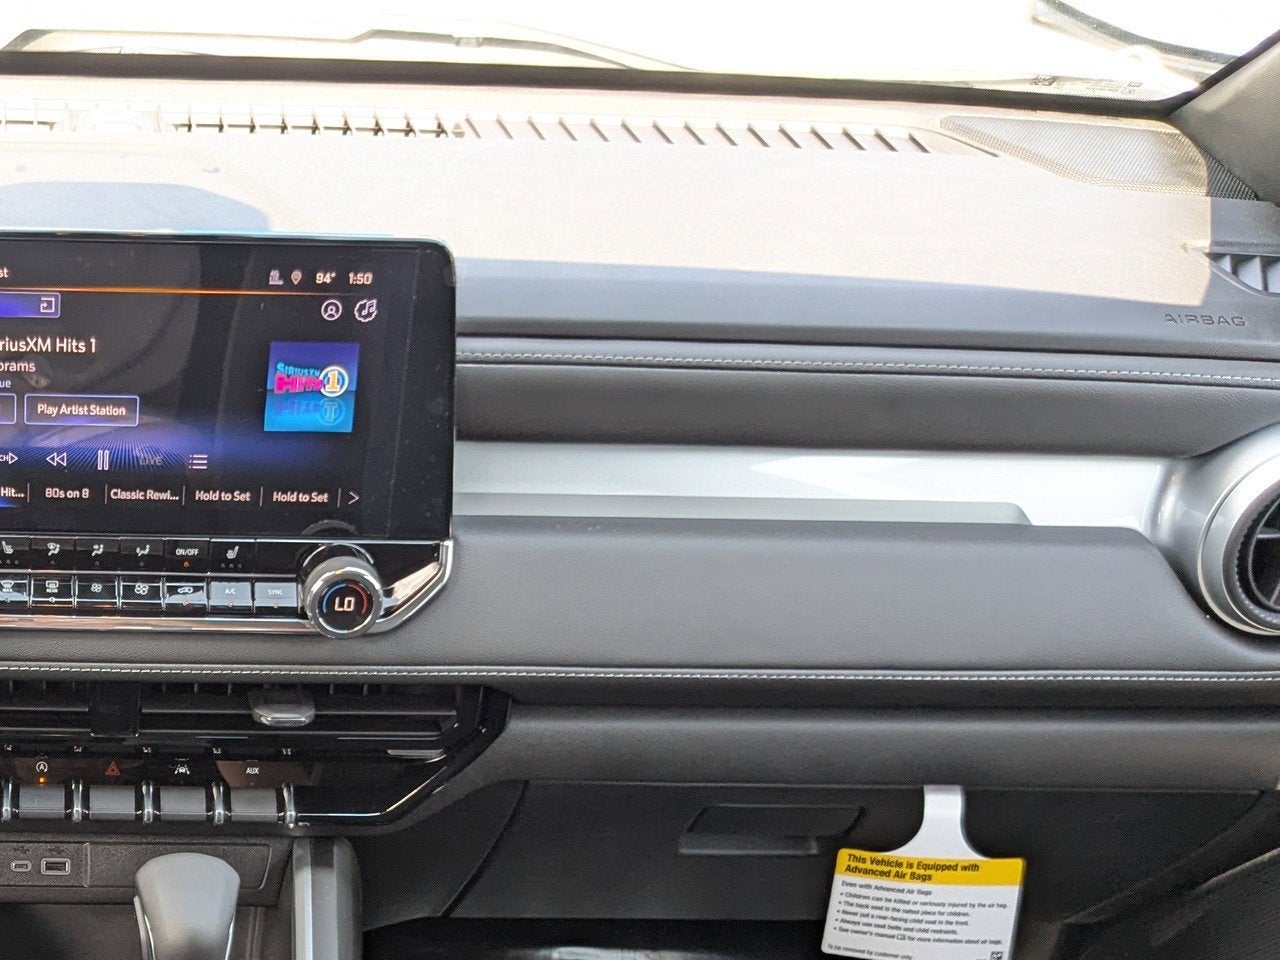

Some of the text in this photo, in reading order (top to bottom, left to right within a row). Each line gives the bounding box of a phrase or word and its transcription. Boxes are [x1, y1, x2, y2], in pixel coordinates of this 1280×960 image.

[348, 271, 373, 285] 1:50
[1164, 314, 1246, 327] AIRBAG
[56, 338, 86, 353] Hits
[91, 338, 96, 353] 1
[275, 370, 340, 395] HITS 1
[37, 404, 126, 417] Play Artist Station
[140, 456, 163, 466] LIVE
[45, 488, 90, 498] 80s on 8
[110, 488, 143, 499] Classic
[195, 490, 251, 502] Hold to Set
[272, 491, 329, 503] Hold to Set
[176, 548, 199, 556] ON/OFF
[224, 587, 237, 595] A/C
[335, 597, 355, 612] LO
[245, 767, 259, 775] AUX
[847, 853, 980, 873] This Vehicle is Equipped with
[845, 864, 932, 883] Advanced Air Bags
